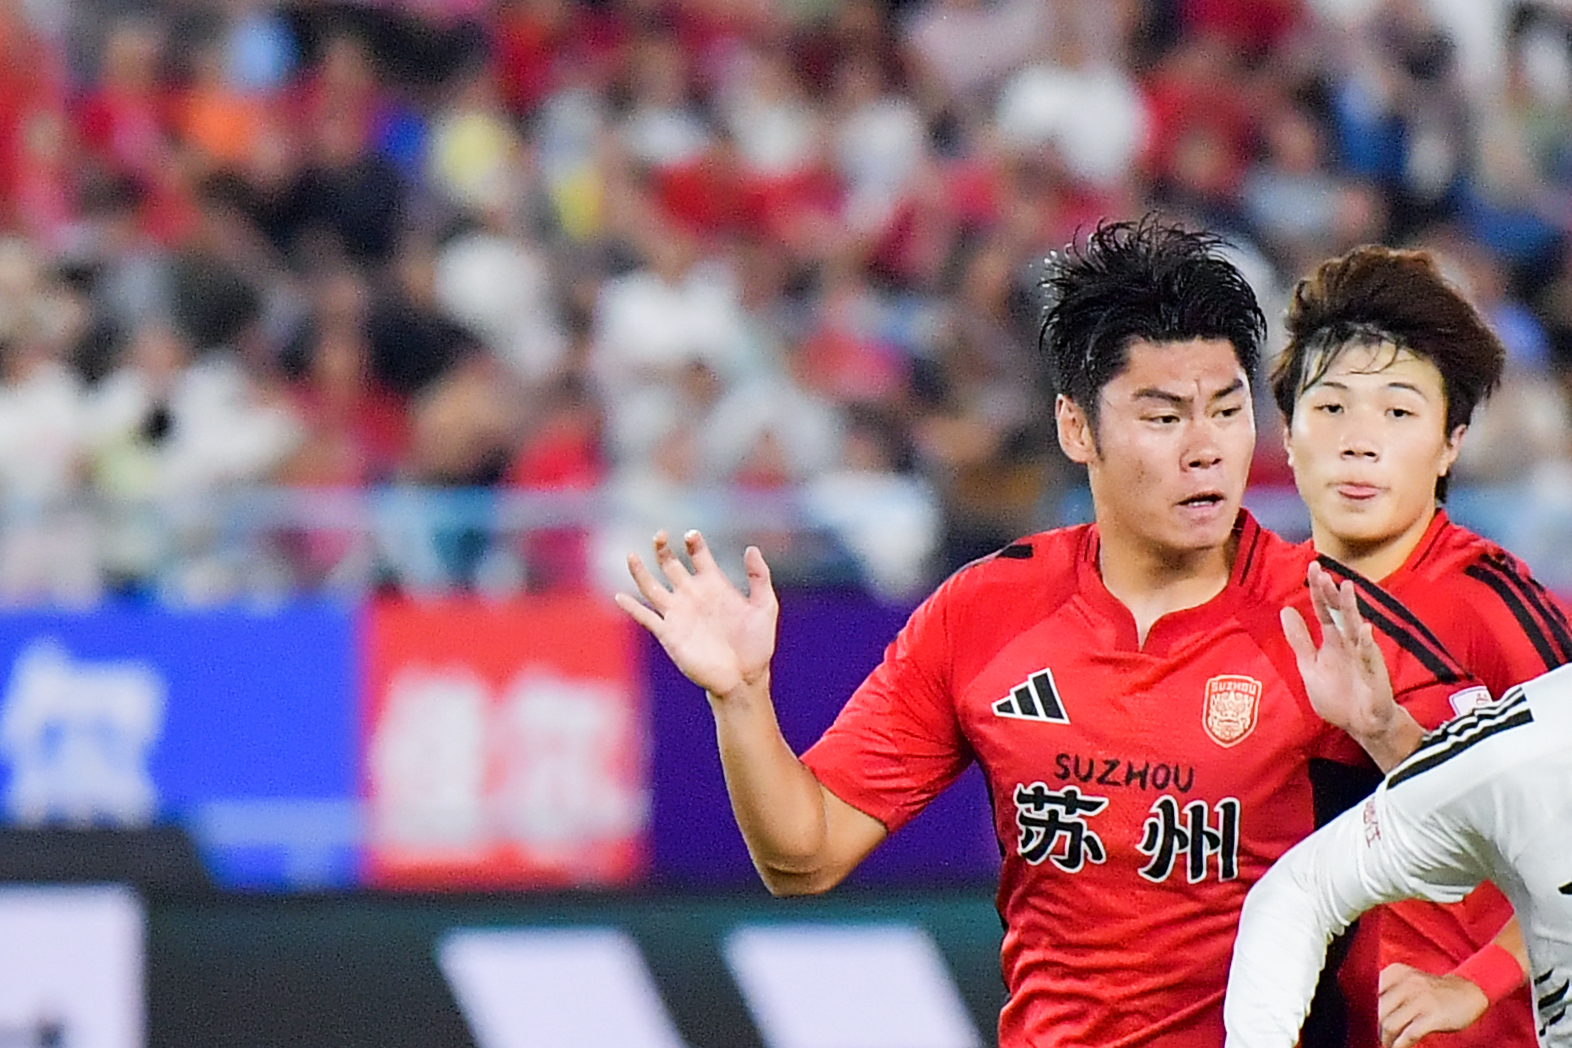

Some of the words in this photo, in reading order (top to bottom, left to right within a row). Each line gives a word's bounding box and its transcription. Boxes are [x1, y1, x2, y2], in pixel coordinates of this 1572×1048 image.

[1210, 681, 1256, 696] SUZHOU
[1054, 753, 1195, 793] SUZHOU
[1014, 782, 1241, 884] 苏州
